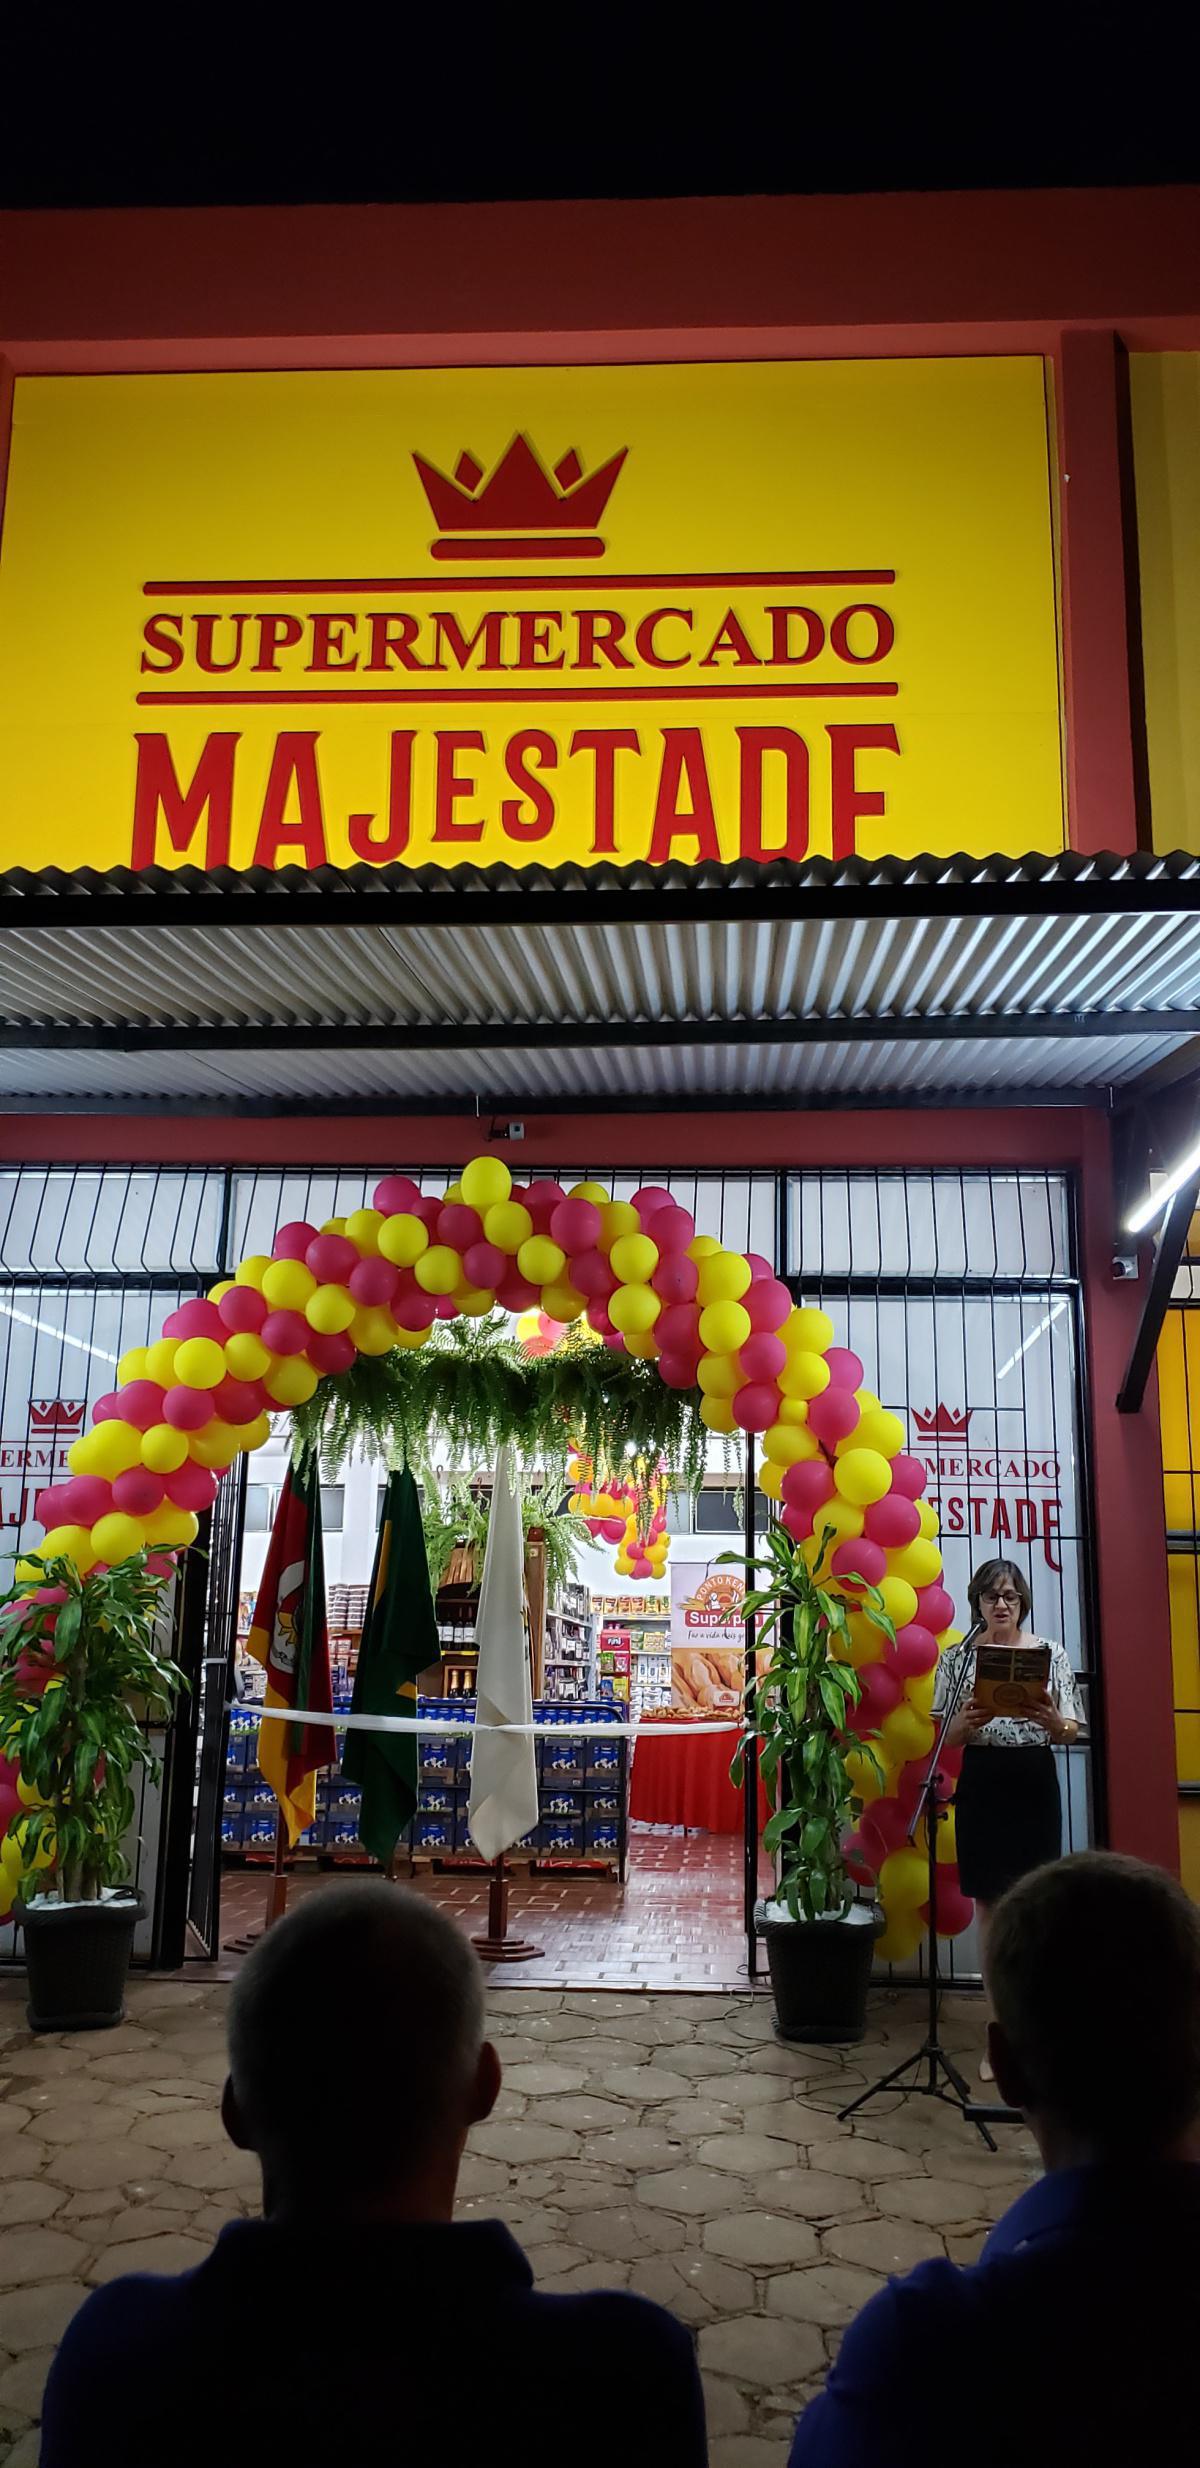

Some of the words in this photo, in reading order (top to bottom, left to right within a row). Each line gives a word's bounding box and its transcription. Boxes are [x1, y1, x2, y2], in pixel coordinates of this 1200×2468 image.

[140, 603, 895, 675] SUPERMERCADO
[131, 722, 901, 869] MAJESTADE
[914, 1457, 1061, 1479] MERCADO
[696, 1576, 723, 1601] PONTO
